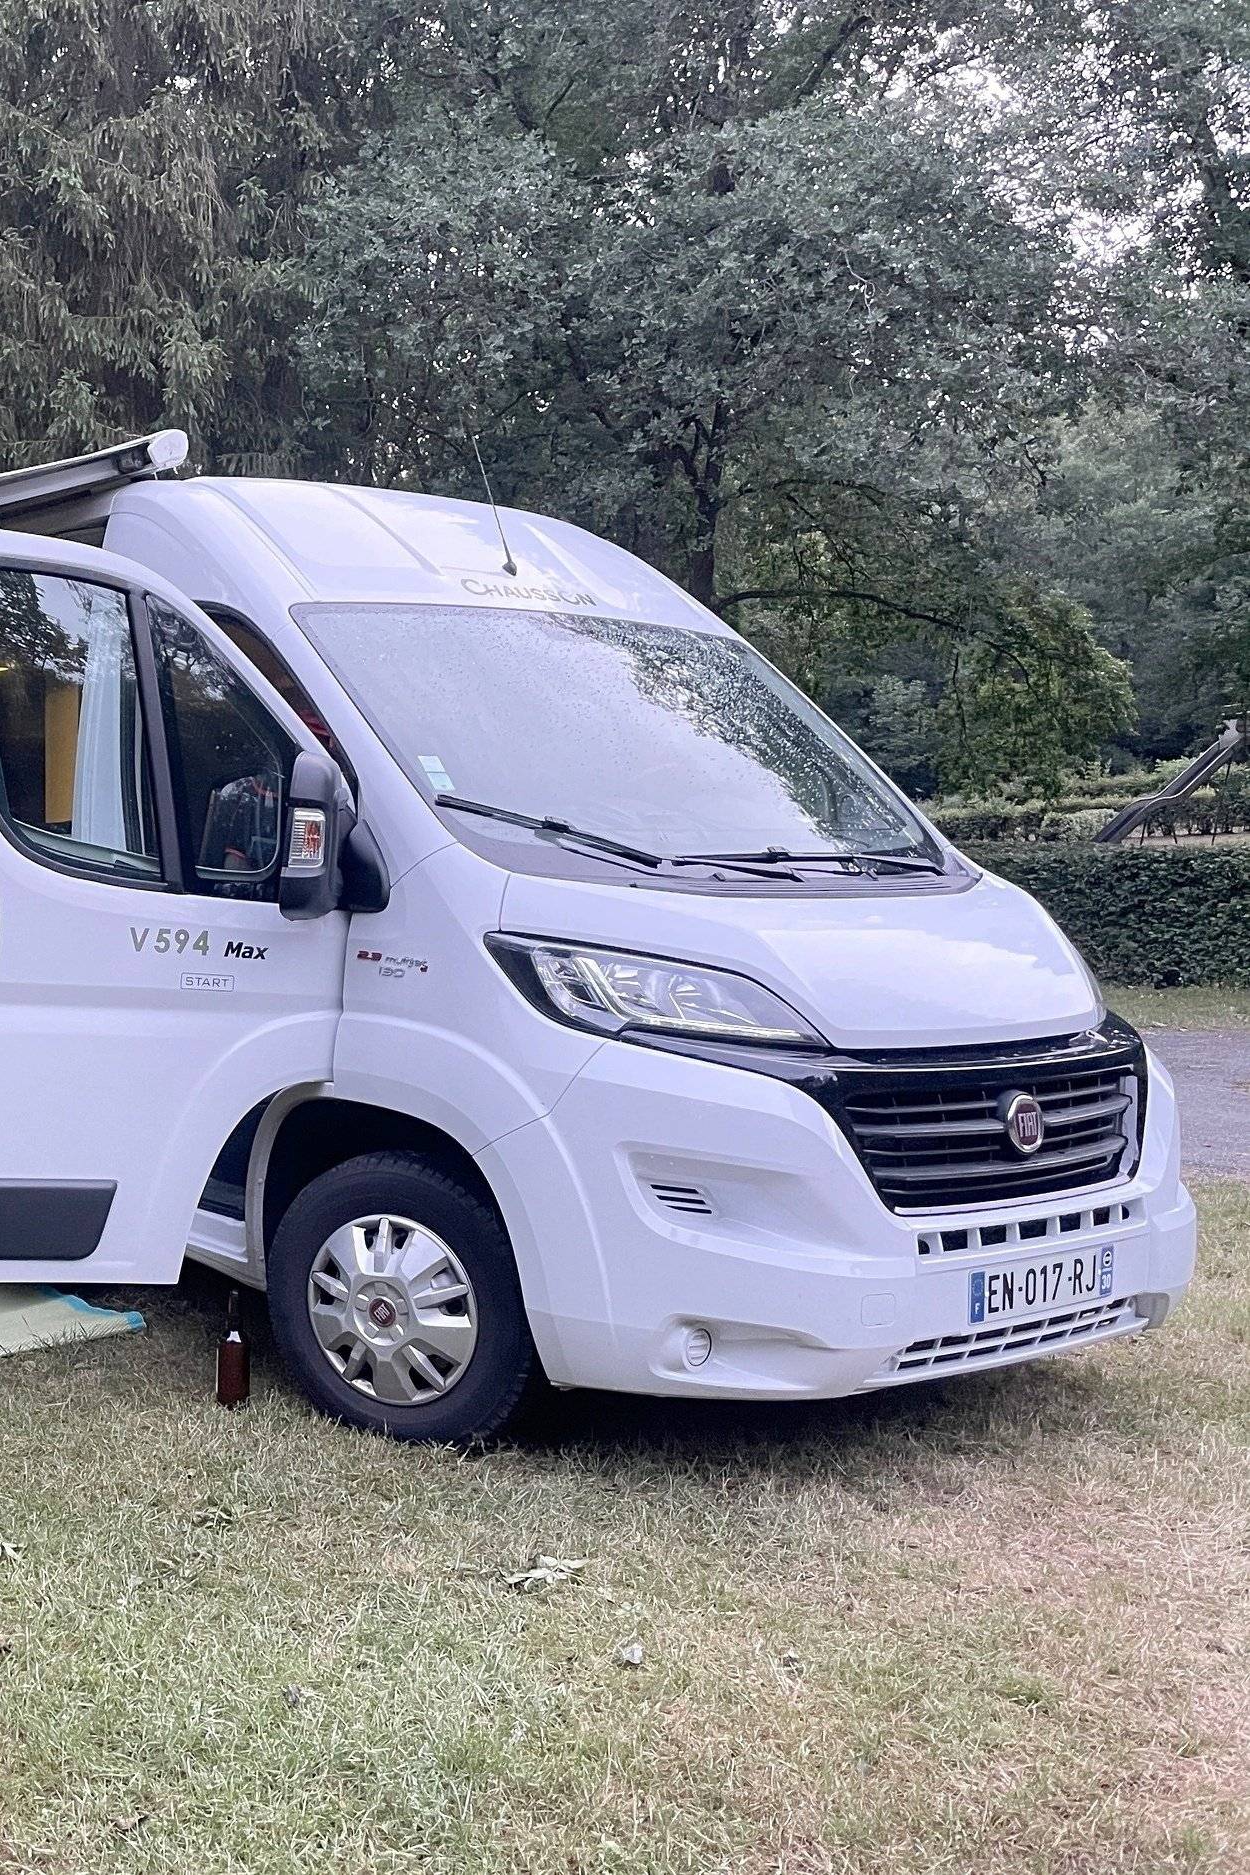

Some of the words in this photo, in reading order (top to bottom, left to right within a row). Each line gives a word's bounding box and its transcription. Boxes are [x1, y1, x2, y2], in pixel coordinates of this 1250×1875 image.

[224, 941, 269, 960] Max
[185, 975, 230, 989] START
[1017, 1111, 1037, 1137] FIAT
[1101, 1274, 1111, 1289] 30
[974, 1302, 981, 1315] F
